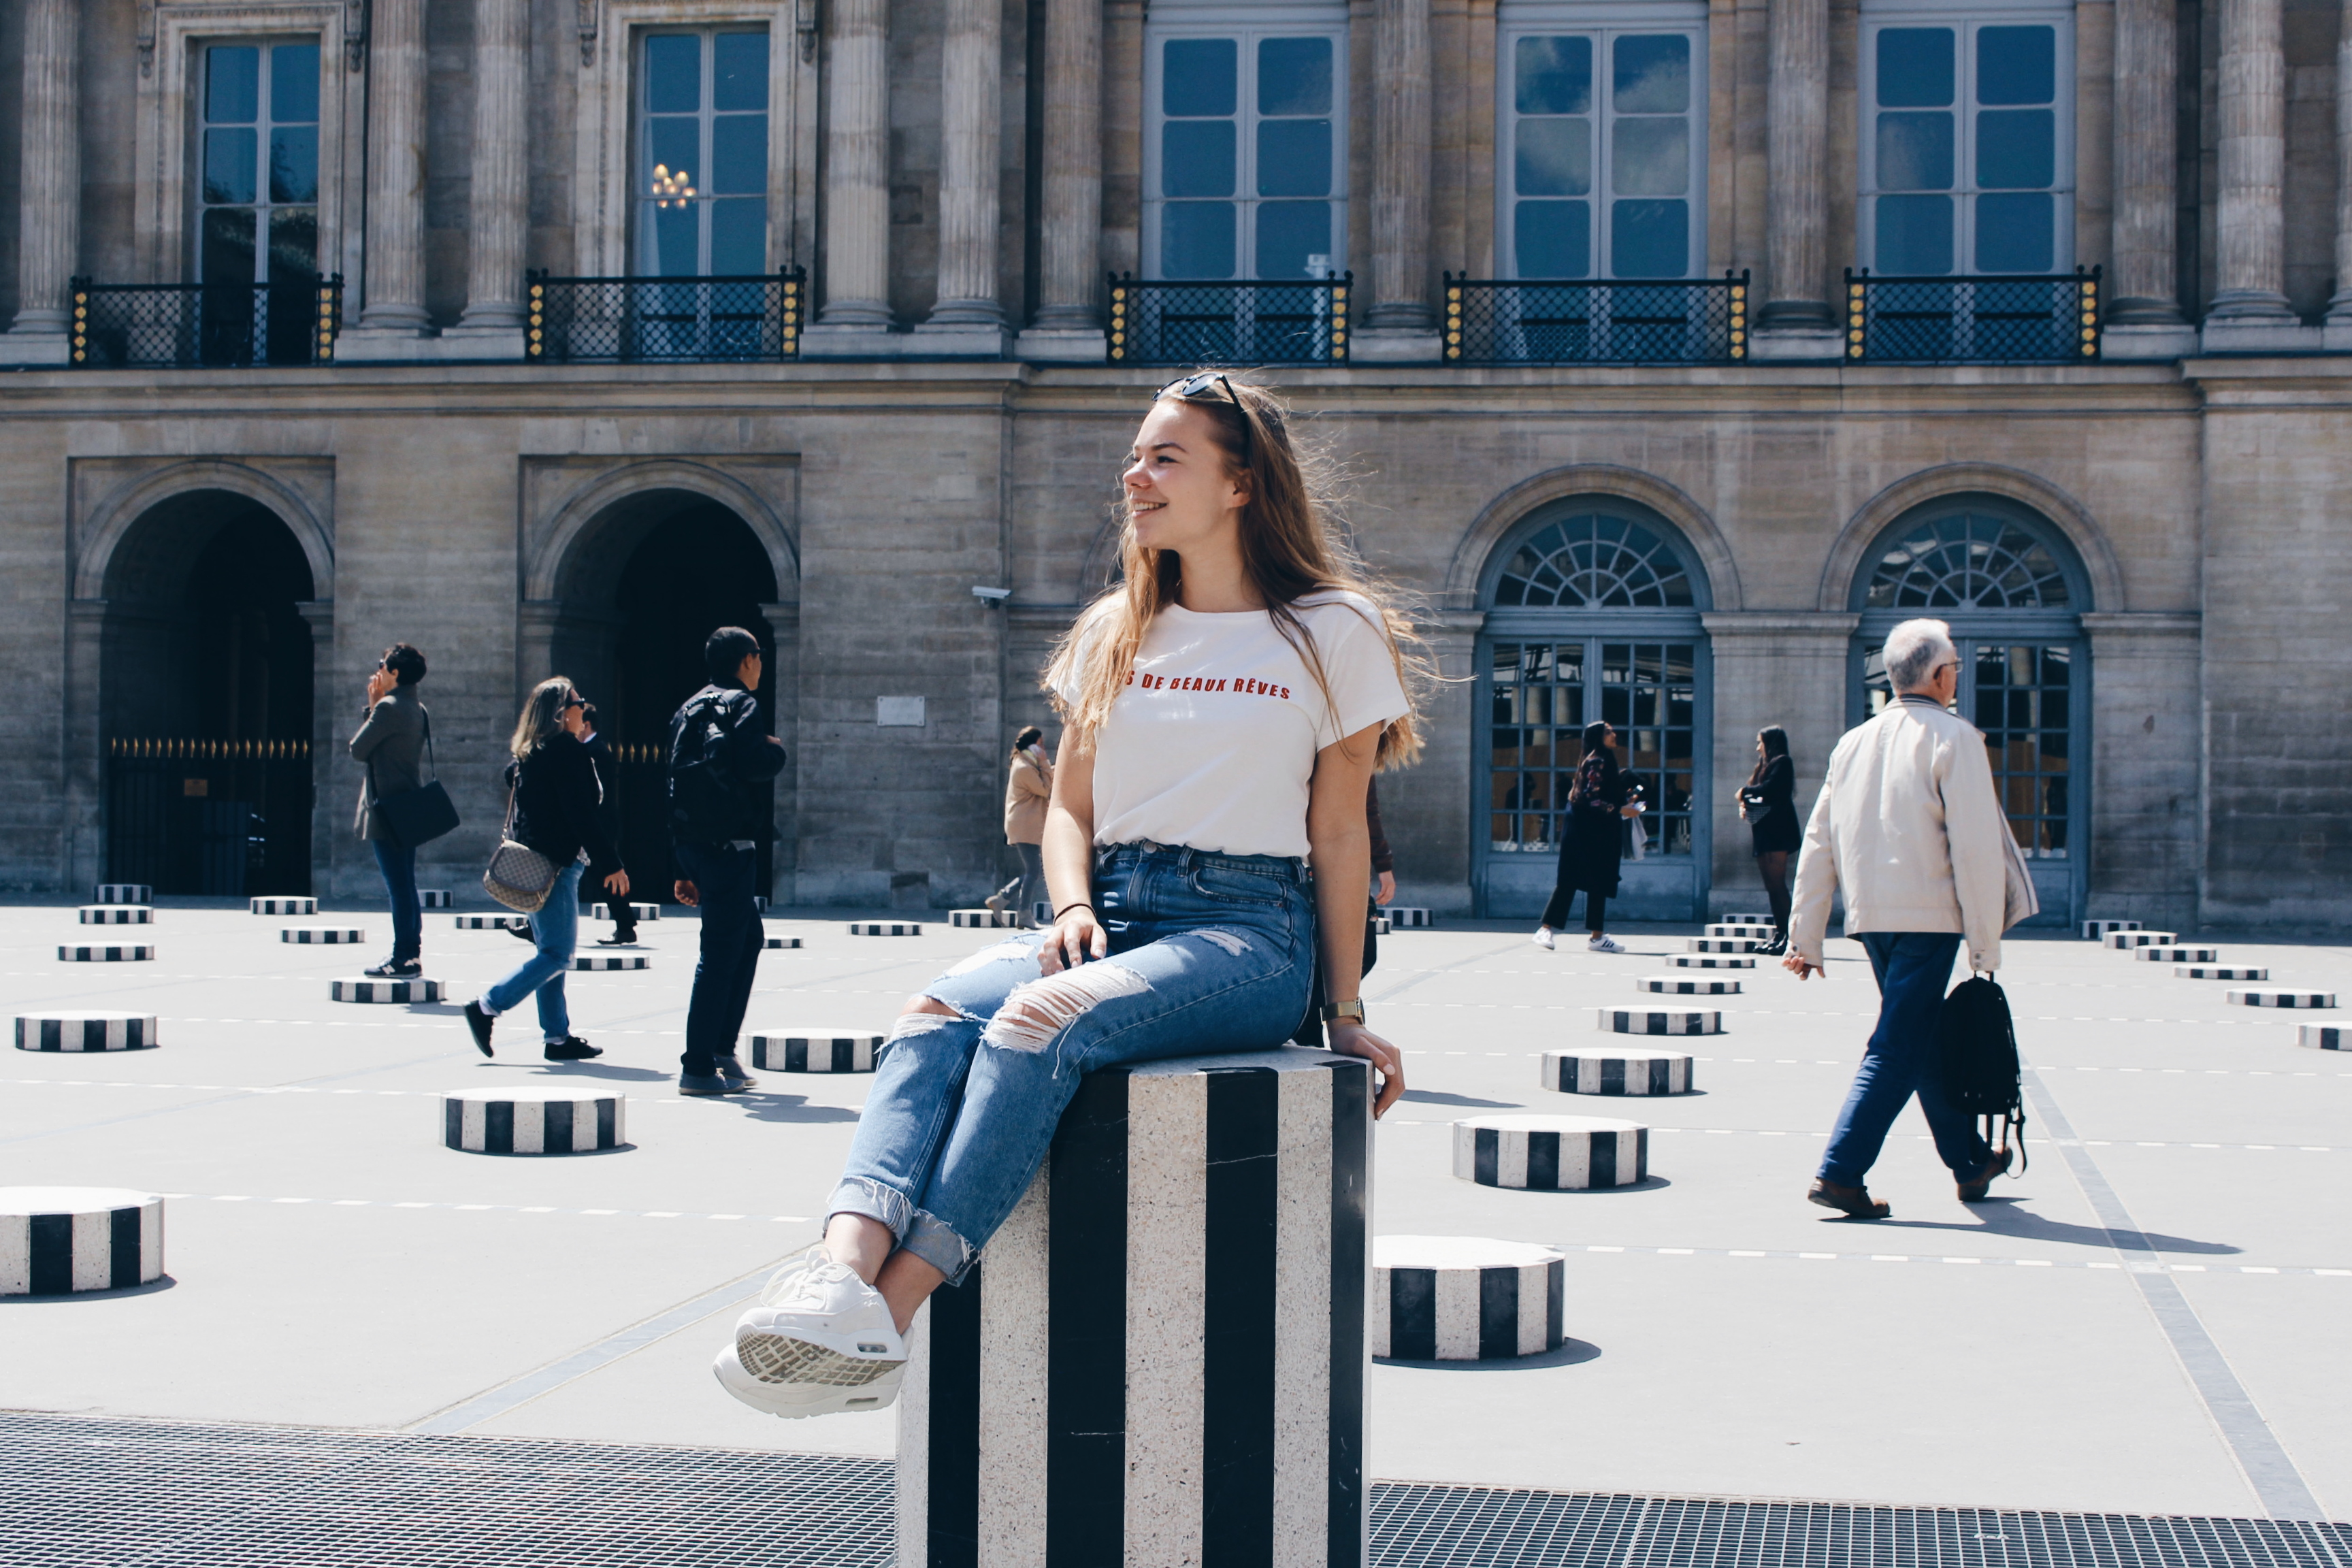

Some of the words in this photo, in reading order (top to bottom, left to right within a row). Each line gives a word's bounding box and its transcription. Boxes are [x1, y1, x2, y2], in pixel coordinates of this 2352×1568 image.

[1141, 674, 1164, 689] DE
[1169, 677, 1227, 691] BEAUX
[1233, 678, 1290, 700] RÊVES
